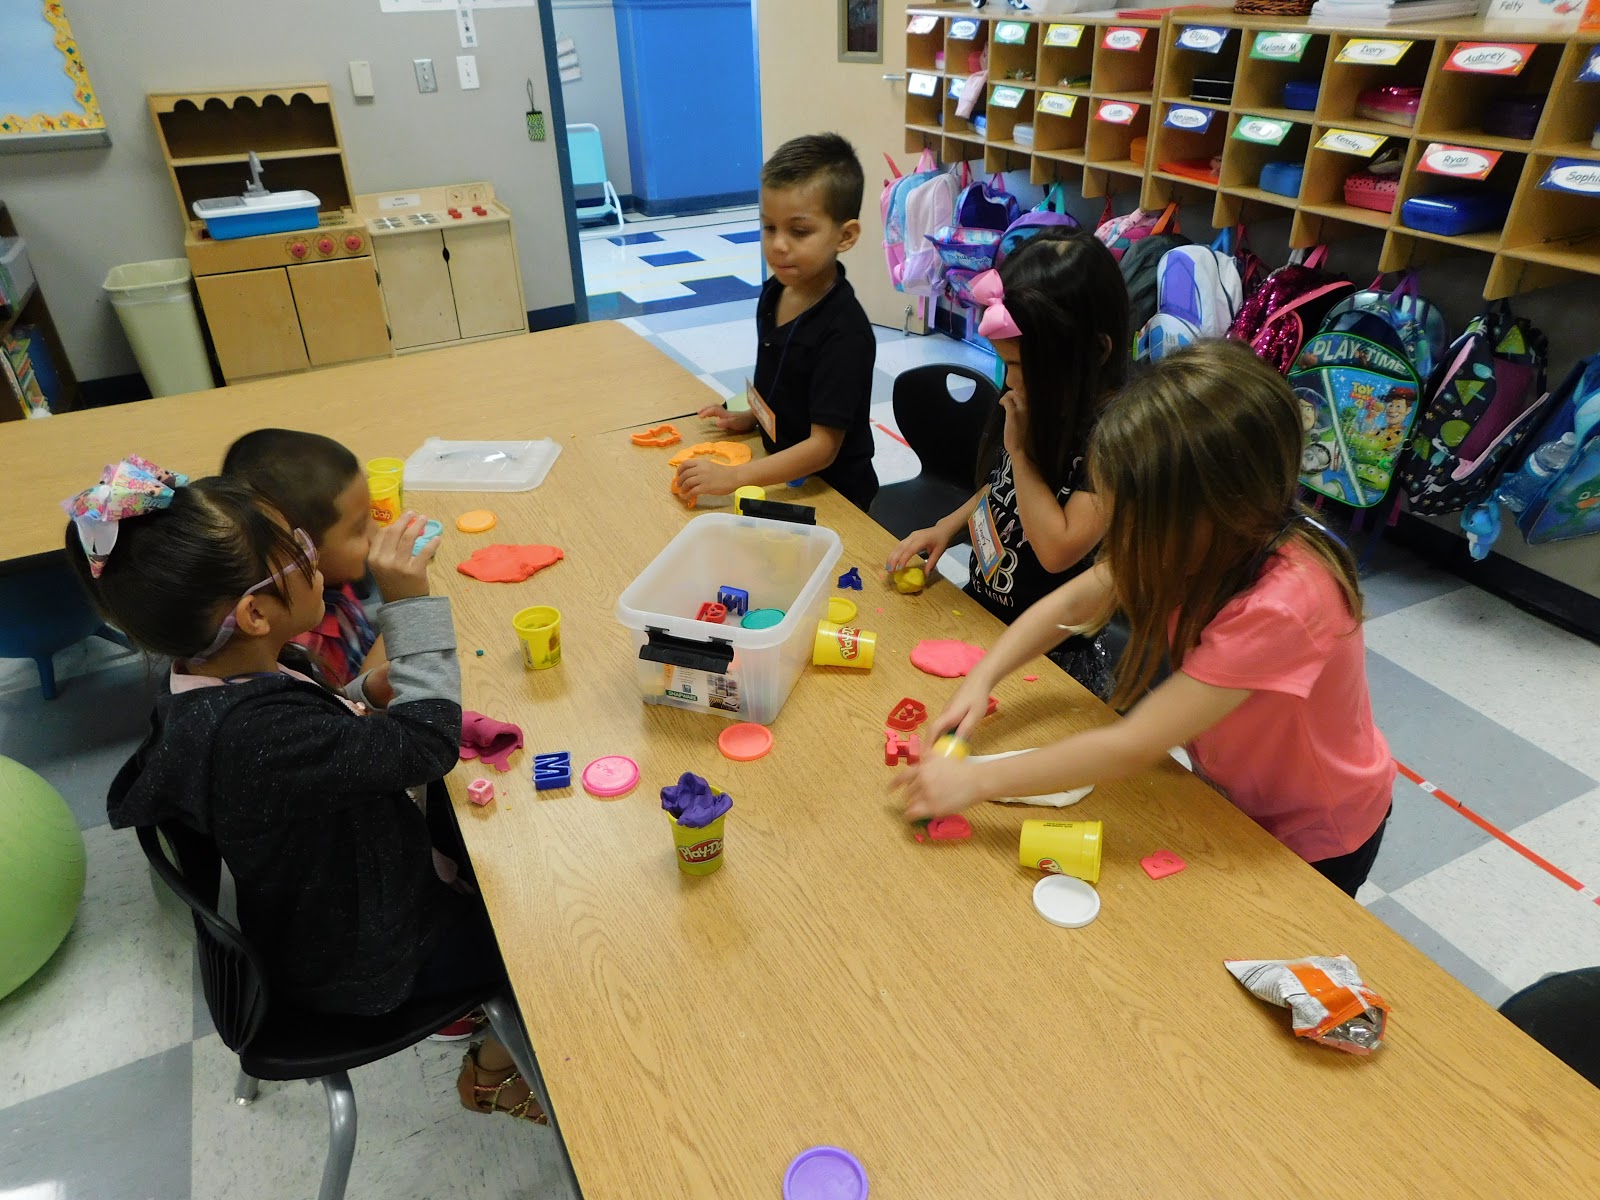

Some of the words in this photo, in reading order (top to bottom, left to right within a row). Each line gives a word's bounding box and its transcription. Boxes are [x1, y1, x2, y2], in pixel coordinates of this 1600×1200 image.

[1189, 30, 1209, 43] Elijah
[1260, 41, 1286, 51] Melanie
[1288, 43, 1297, 52] M
[1360, 45, 1386, 54] Ivory
[1463, 51, 1507, 63] Aubrey
[1109, 108, 1123, 117] Liam
[1172, 113, 1200, 124] Benjamin
[1336, 134, 1363, 151] Kensley
[1442, 155, 1469, 165] Ryan
[1565, 170, 1600, 184] Sophi
[1312, 339, 1360, 361] PLAY
[1366, 346, 1407, 374] TIME
[1351, 381, 1376, 396] TOY
